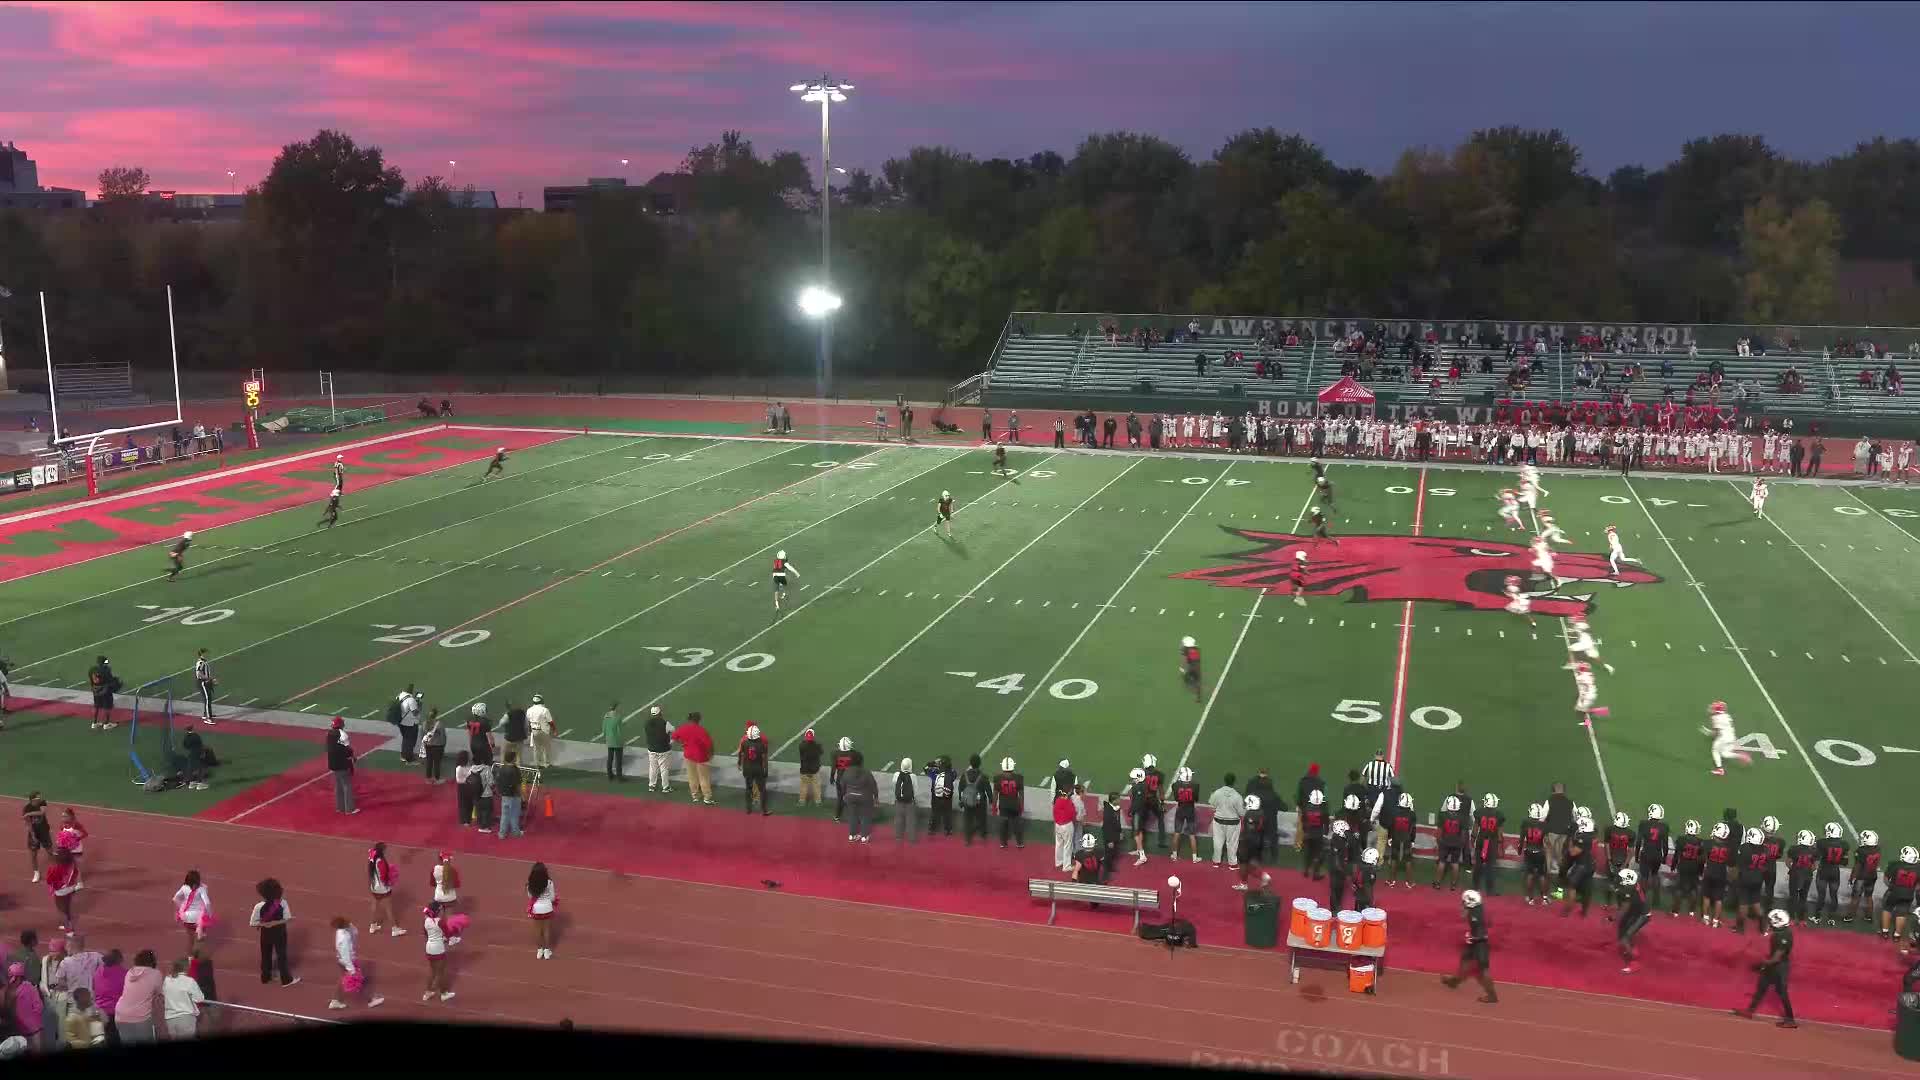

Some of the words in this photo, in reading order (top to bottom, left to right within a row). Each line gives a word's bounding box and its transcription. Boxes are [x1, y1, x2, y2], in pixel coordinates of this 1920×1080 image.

[371, 625, 491, 648] 20
[660, 647, 776, 672] 30
[975, 673, 1099, 699] 40
[1331, 699, 1463, 730] 50
[1343, 927, 1352, 937] G
[1276, 1029, 1449, 1075] COACH
